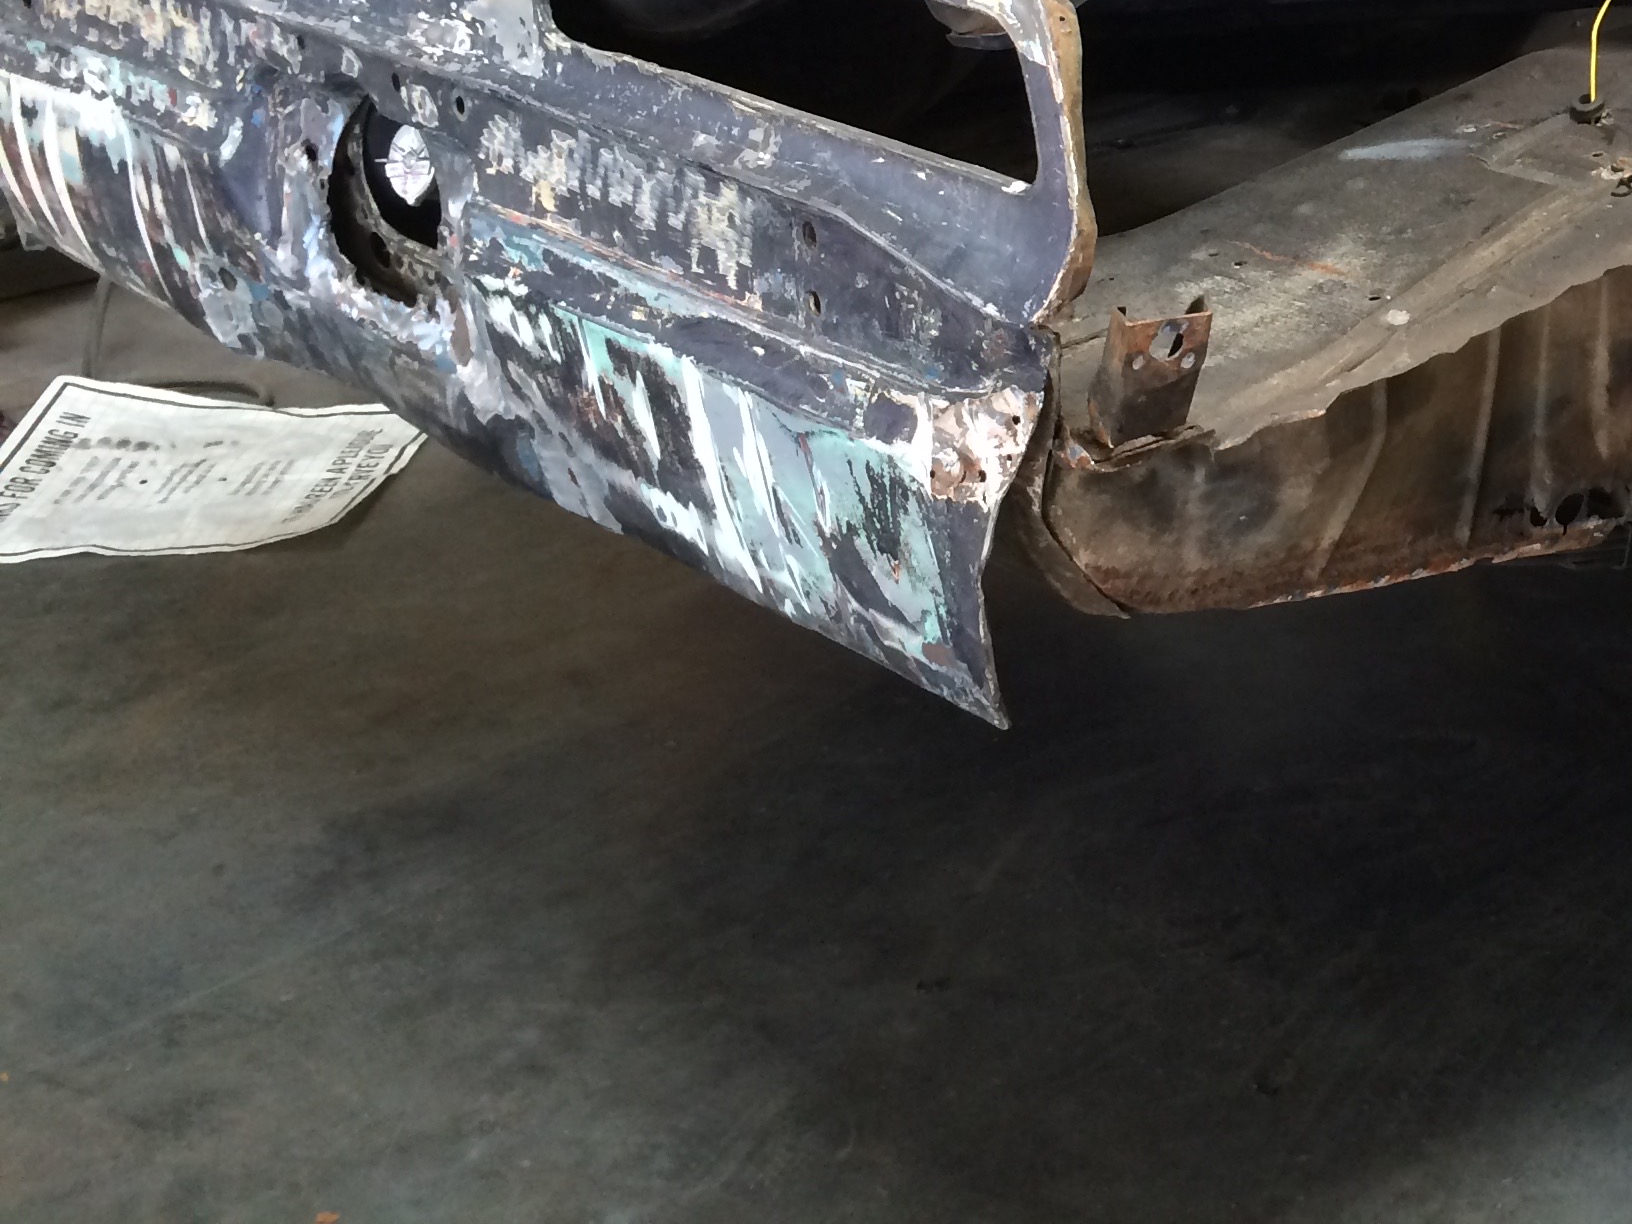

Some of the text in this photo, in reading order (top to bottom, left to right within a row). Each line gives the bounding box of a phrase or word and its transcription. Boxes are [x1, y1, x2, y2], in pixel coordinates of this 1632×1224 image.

[55, 411, 91, 429] IN
[18, 428, 79, 475] COMING
[0, 476, 43, 500] FOR
